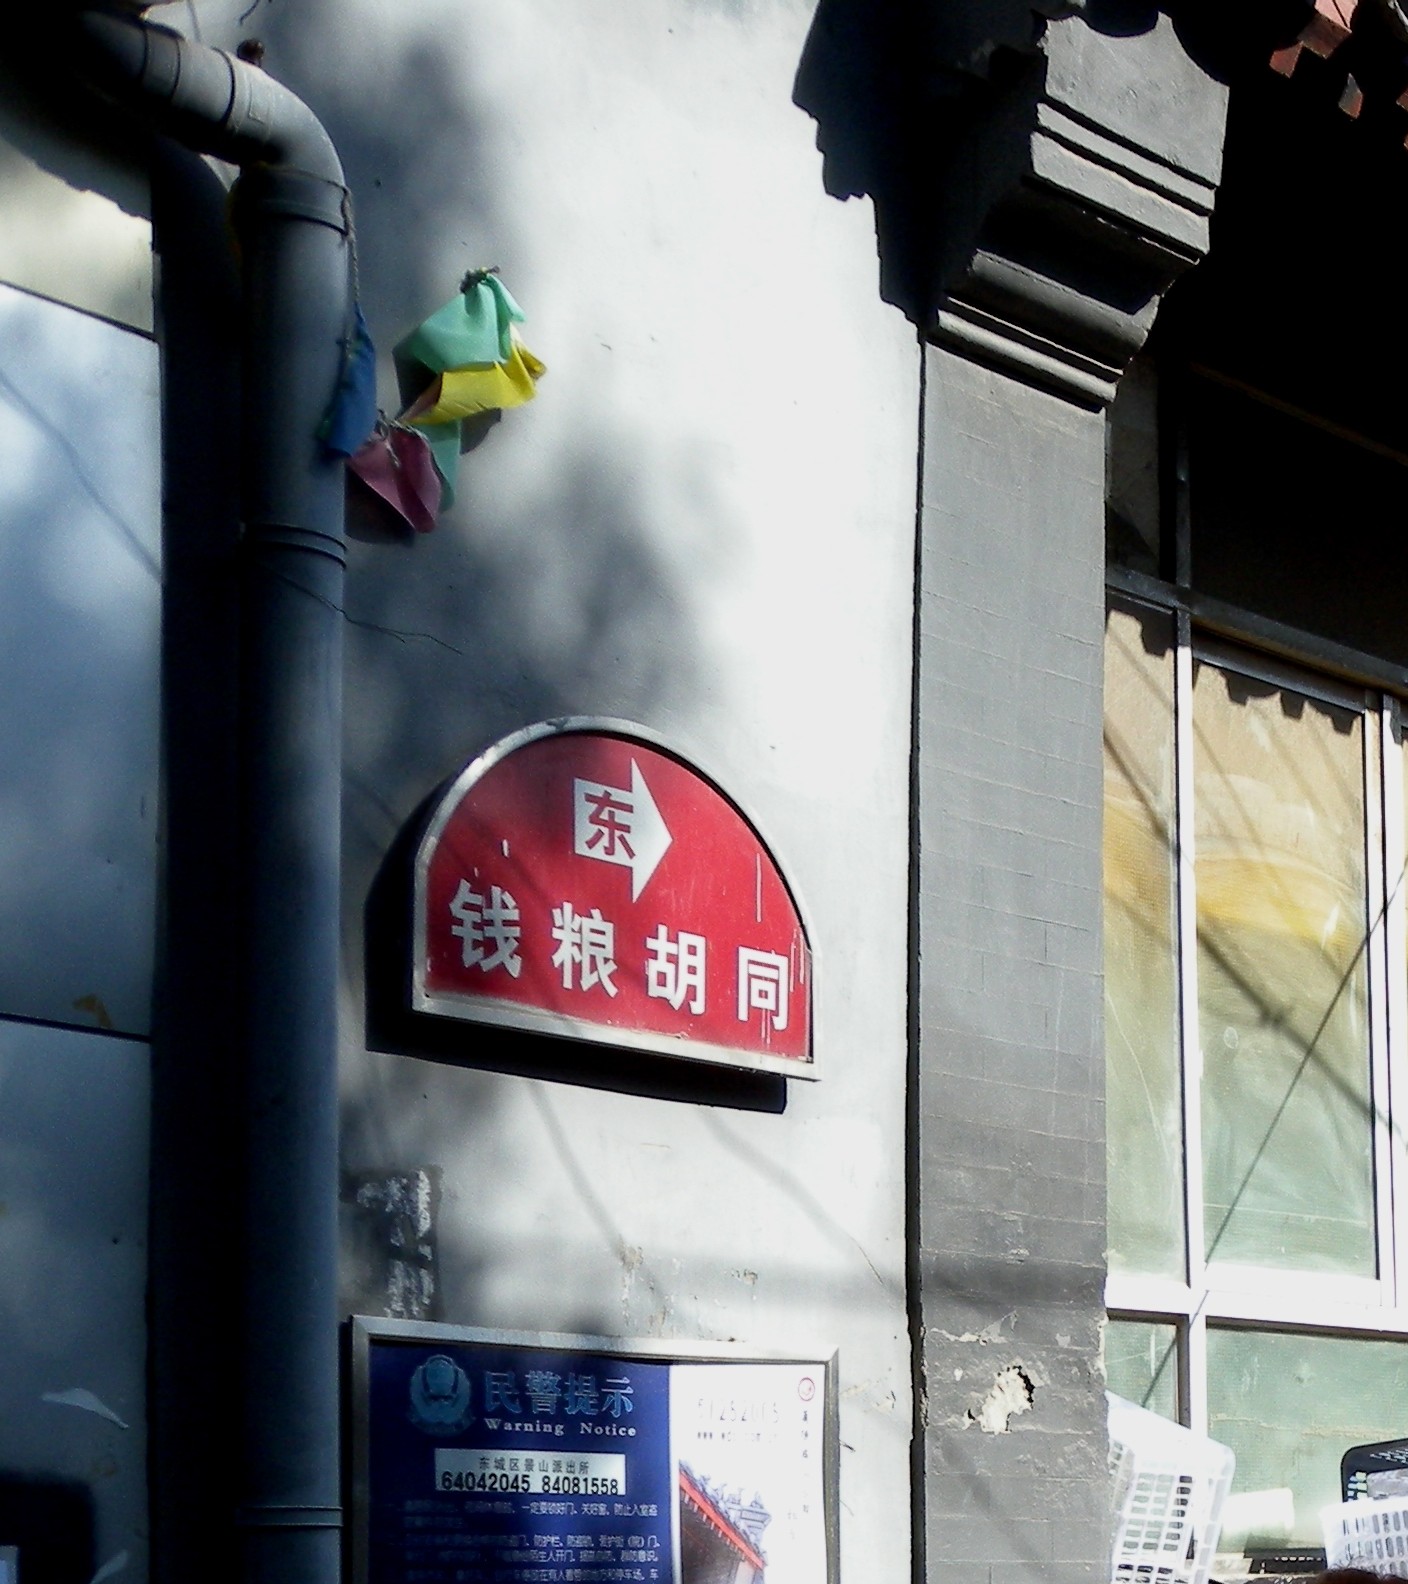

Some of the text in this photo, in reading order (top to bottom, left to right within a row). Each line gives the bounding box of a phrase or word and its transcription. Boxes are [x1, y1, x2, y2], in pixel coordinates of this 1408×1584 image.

[583, 790, 636, 860] 东
[449, 879, 790, 1031] 钱粮胡同
[484, 1370, 634, 1418] 民警提示
[484, 1418, 637, 1437] Warning Notice
[441, 1472, 618, 1495] 64042045 84081558
[479, 1457, 590, 1475] 东城区景山派出所
